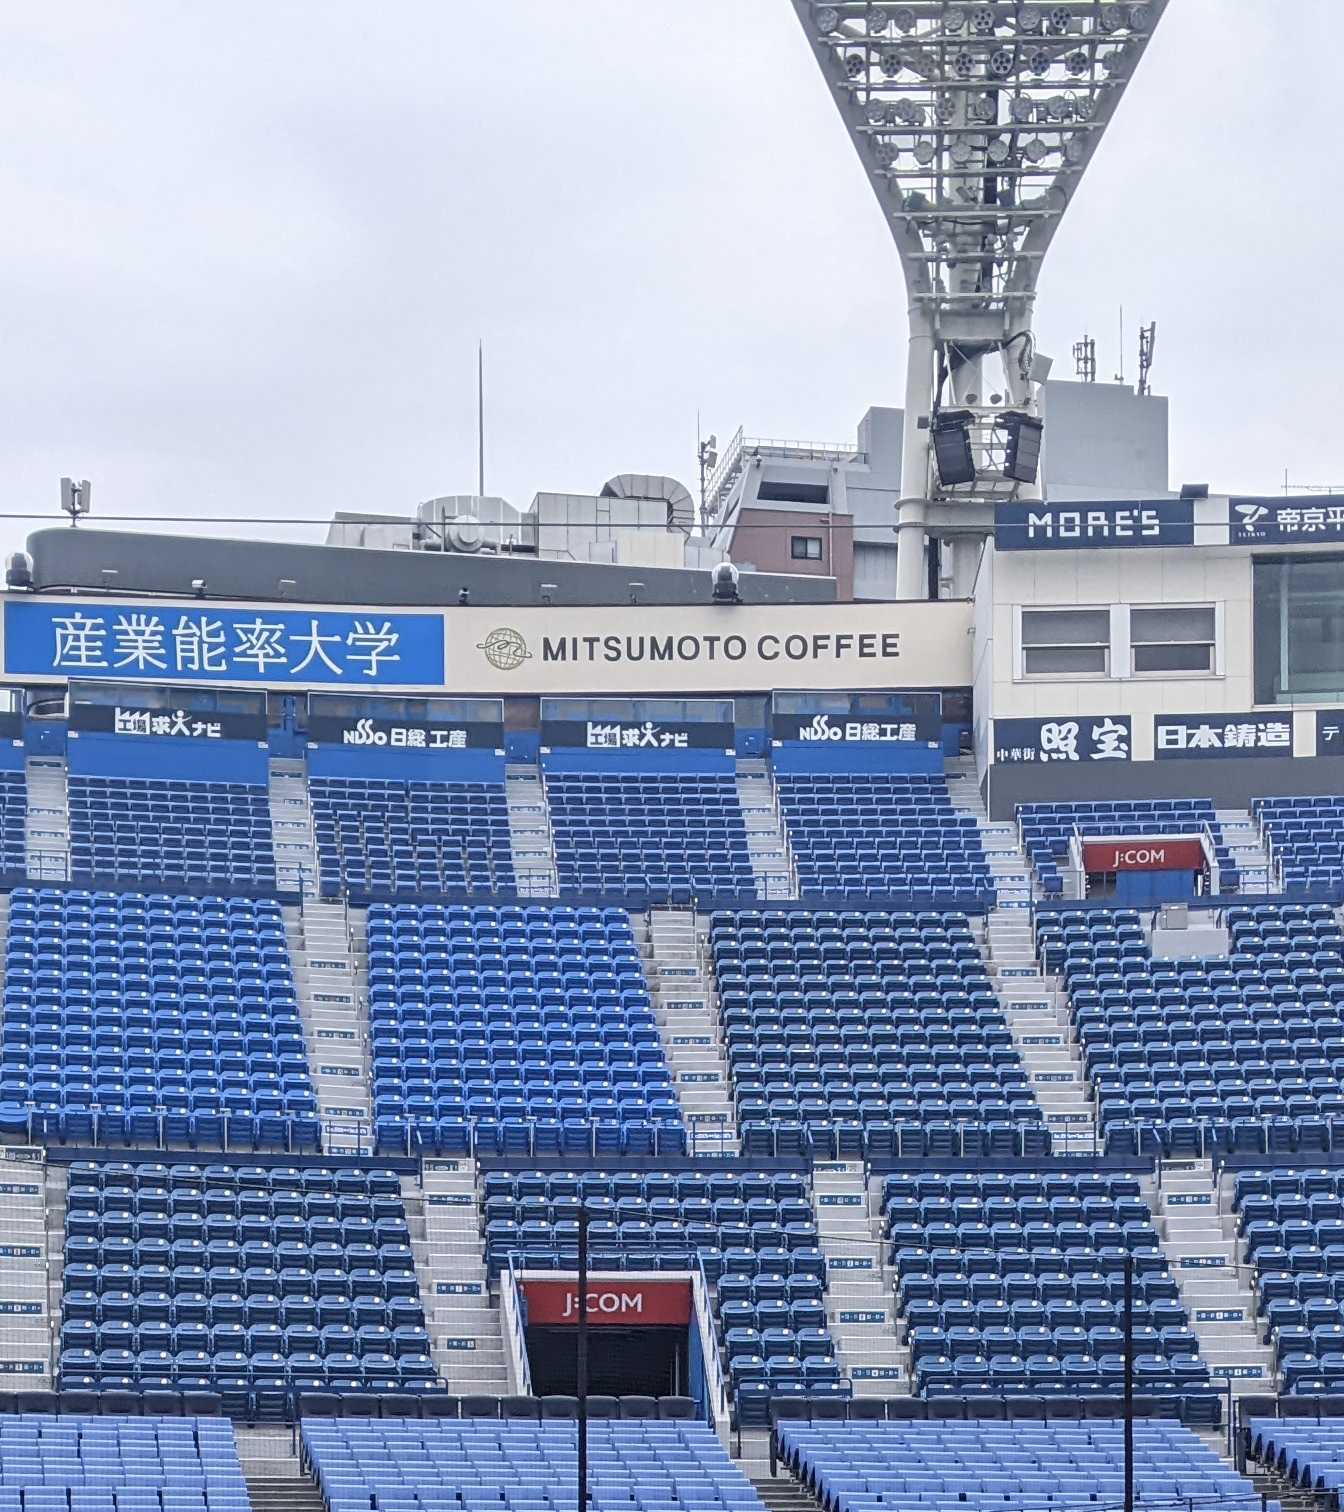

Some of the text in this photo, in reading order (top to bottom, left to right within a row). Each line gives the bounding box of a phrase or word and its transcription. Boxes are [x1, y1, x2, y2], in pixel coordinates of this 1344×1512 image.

[51, 613, 402, 677] 産業能率大学
[542, 632, 901, 662] MITSUMOTO COFFEE
[389, 726, 468, 749] 日総工産
[844, 722, 917, 743] 日総工産
[1156, 721, 1291, 750] 日本鋳造
[1112, 849, 1165, 868] J:COM
[562, 1292, 643, 1317] J:COM
